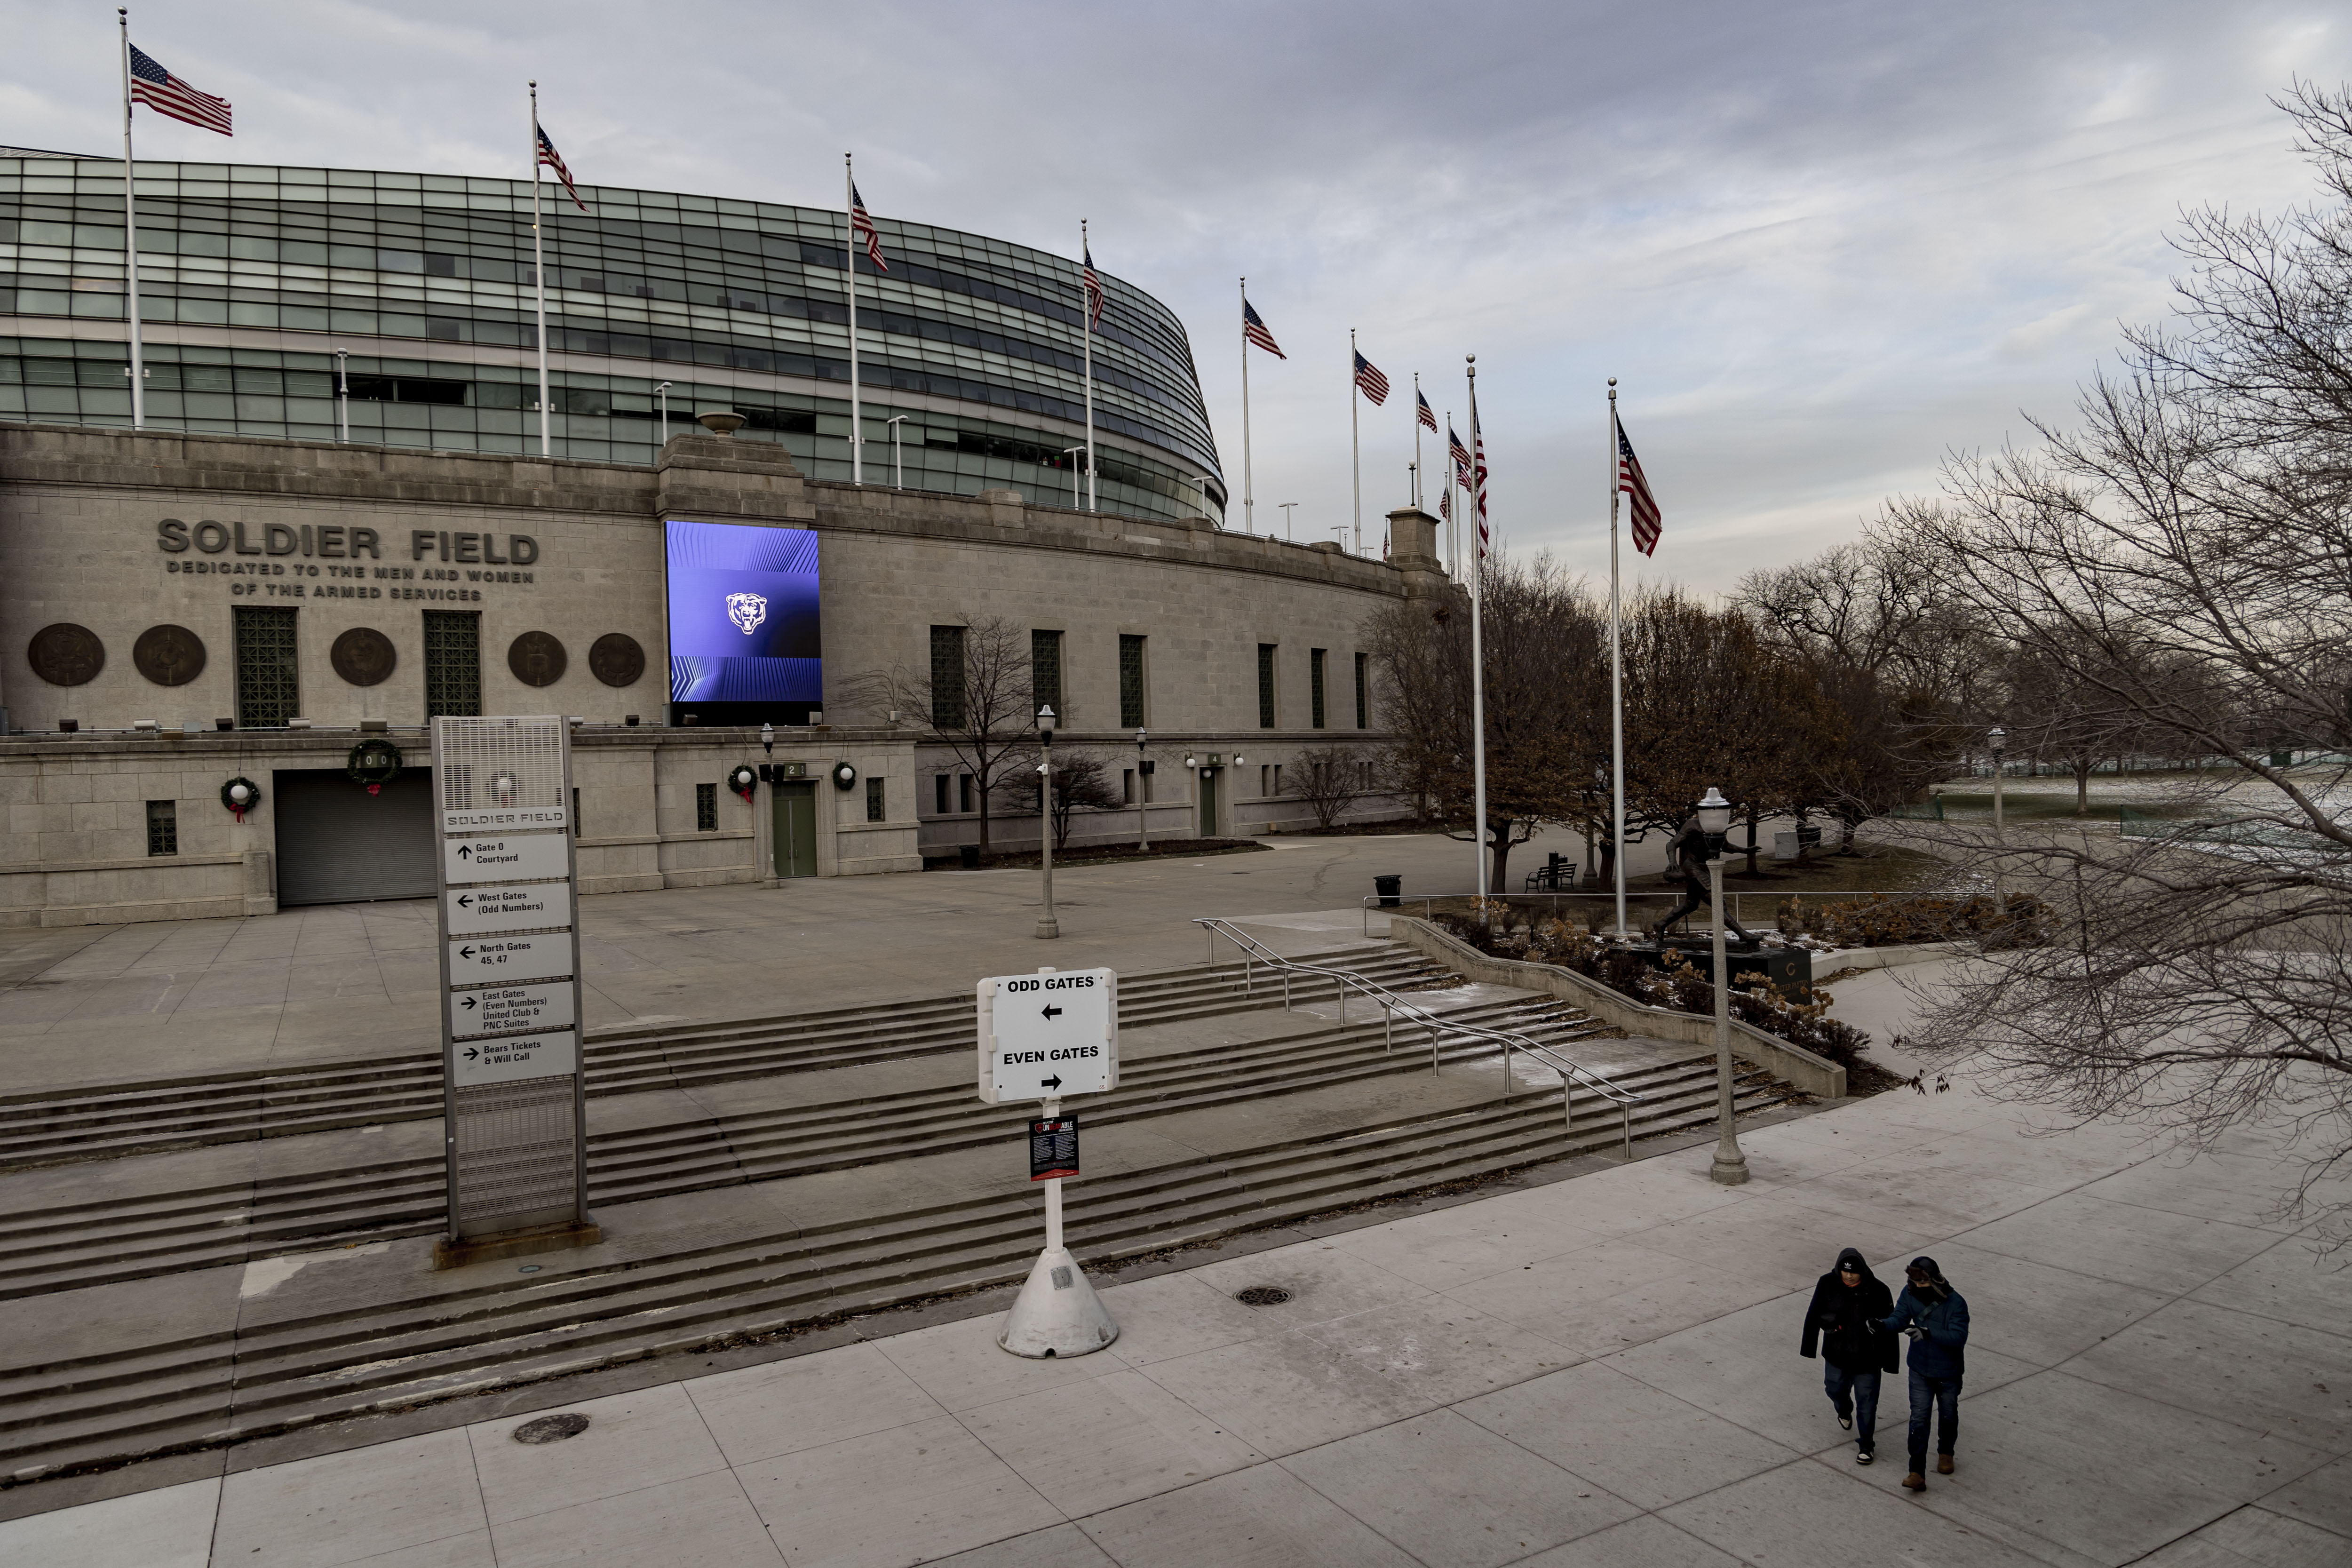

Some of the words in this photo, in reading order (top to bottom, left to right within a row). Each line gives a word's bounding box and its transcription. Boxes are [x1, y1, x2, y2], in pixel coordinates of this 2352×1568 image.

[157, 518, 380, 558] SOLDIER
[412, 530, 539, 564] FIELD
[167, 560, 285, 574] DEDICATED
[294, 564, 319, 577] TO
[328, 565, 365, 578] THE
[374, 566, 414, 579] MEN
[422, 569, 460, 581] AND
[467, 570, 534, 583] WOMEN
[231, 583, 257, 595] OF
[266, 584, 304, 597] THE
[313, 585, 381, 598] ARMED
[390, 587, 481, 601] SERVICES
[366, 756, 372, 765] 0
[789, 765, 795, 774] 2
[801, 765, 804, 774] 2
[448, 814, 515, 826] SOLDIER
[520, 812, 563, 822] FIELD
[476, 844, 496, 852] Gate
[477, 853, 518, 864] Courtyard
[478, 893, 500, 902] West
[503, 892, 527, 900] Gates
[478, 905, 499, 915] (Odd
[502, 902, 544, 913] Numbers)
[480, 943, 504, 953] North
[507, 942, 531, 951] Gates
[481, 956, 494, 965] 45,
[497, 955, 508, 963] 47
[1786, 963, 1795, 975] C
[1008, 979, 1040, 993] ODD
[1045, 976, 1094, 990] GATES
[482, 992, 500, 1001] East
[483, 1002, 505, 1011] (Even
[508, 996, 547, 1008] Numbers)
[483, 1011, 510, 1020] United
[512, 1009, 531, 1018] Club
[533, 1007, 540, 1016] &
[484, 1022, 501, 1030] PNC
[504, 1019, 530, 1028] Suites
[484, 1045, 509, 1054] Bears
[510, 1042, 541, 1051] Tickets
[494, 1055, 511, 1063] Will
[514, 1052, 530, 1061] Call
[1004, 1051, 1044, 1065] EVEN
[1050, 1046, 1099, 1060] GATES
[1043, 1121, 1073, 1131] UNBEARABLE
